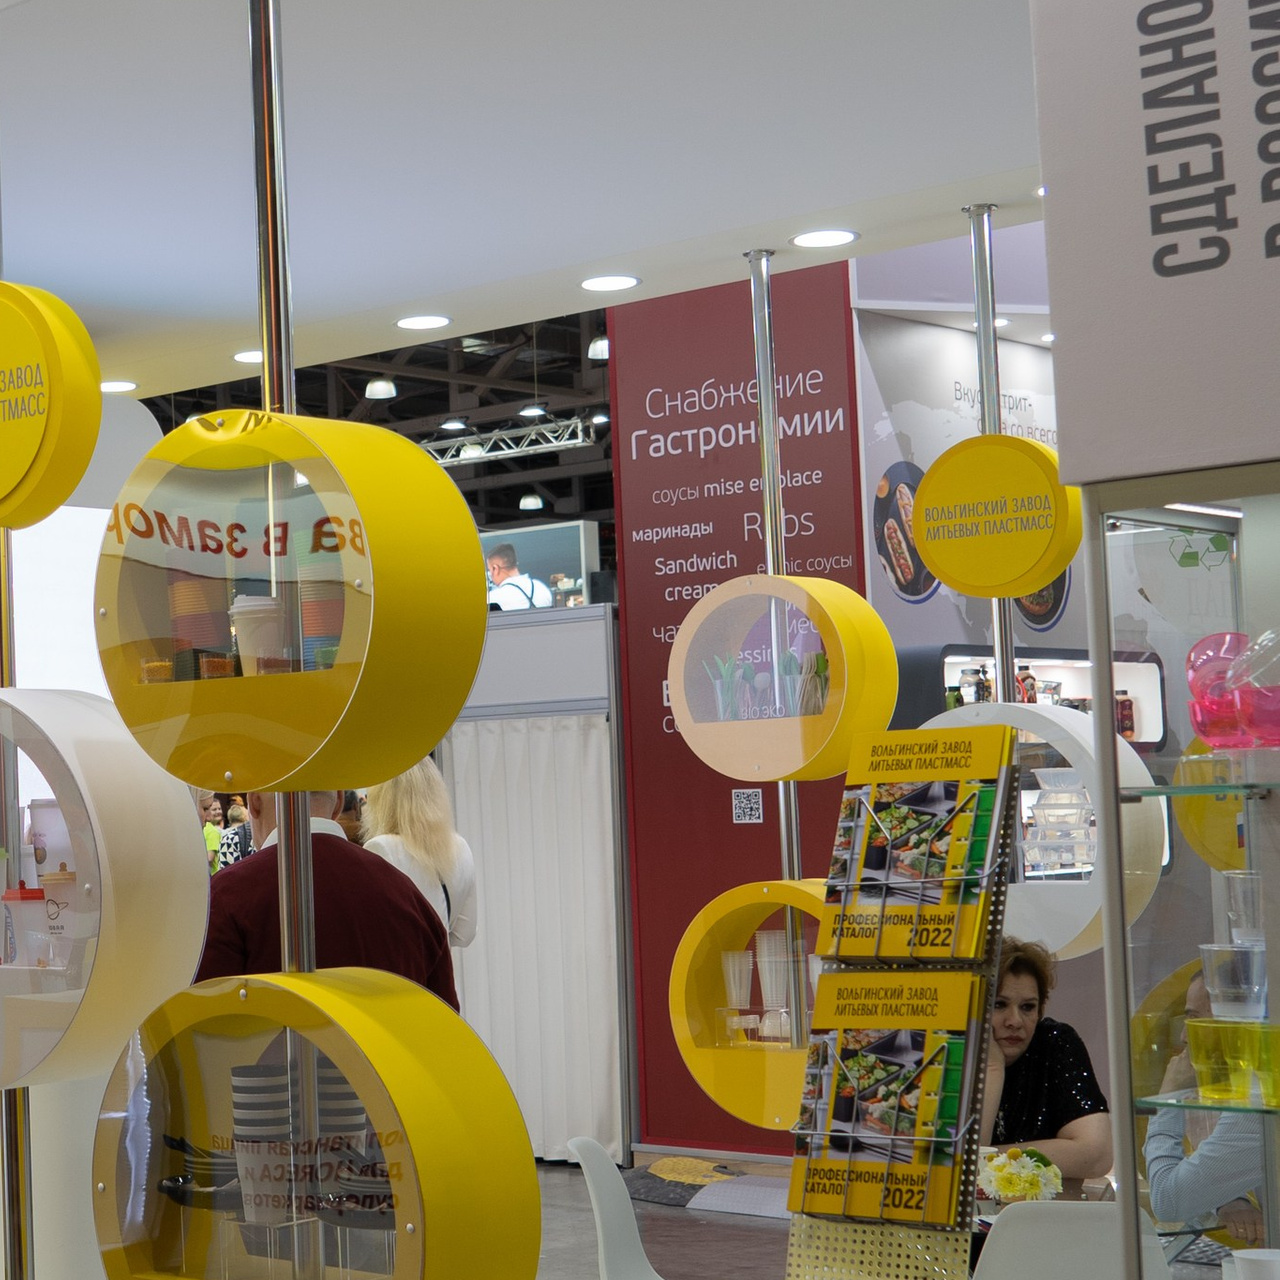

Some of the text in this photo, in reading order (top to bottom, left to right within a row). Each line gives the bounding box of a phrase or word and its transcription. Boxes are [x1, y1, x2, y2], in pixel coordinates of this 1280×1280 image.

[0, 363, 44, 393] ЗАВОД
[631, 407, 844, 460] Гастронмии
[652, 484, 700, 507] соусы
[704, 478, 744, 498] mise
[924, 494, 1052, 523] ВОЛЬГИНСКИЙ ЗАВОД
[632, 521, 713, 543] маринады
[743, 508, 815, 542] Rbs
[925, 513, 1053, 542] ЛИТЬЕВЫХ ПЛАСТМАСС
[654, 550, 738, 575] Sandwich
[806, 554, 853, 574] соусы
[870, 740, 972, 758] ВОЛЬГИНСКИЙ ЗАВОД
[868, 755, 972, 771] ЛИТЬЕВЫХ ПЛАСТМАСС
[833, 911, 955, 926] ПРОФЕССИОНАЛЬНЫЙ
[831, 926, 953, 947] КАТАЛОГ 2022
[836, 985, 938, 1002] ВОЛЬГИНСКИЙ ЗАВОД
[834, 1003, 938, 1017] ЛИТЬЕВЫХ ПЛАСТМАСС
[880, 1187, 926, 1211] 2022
